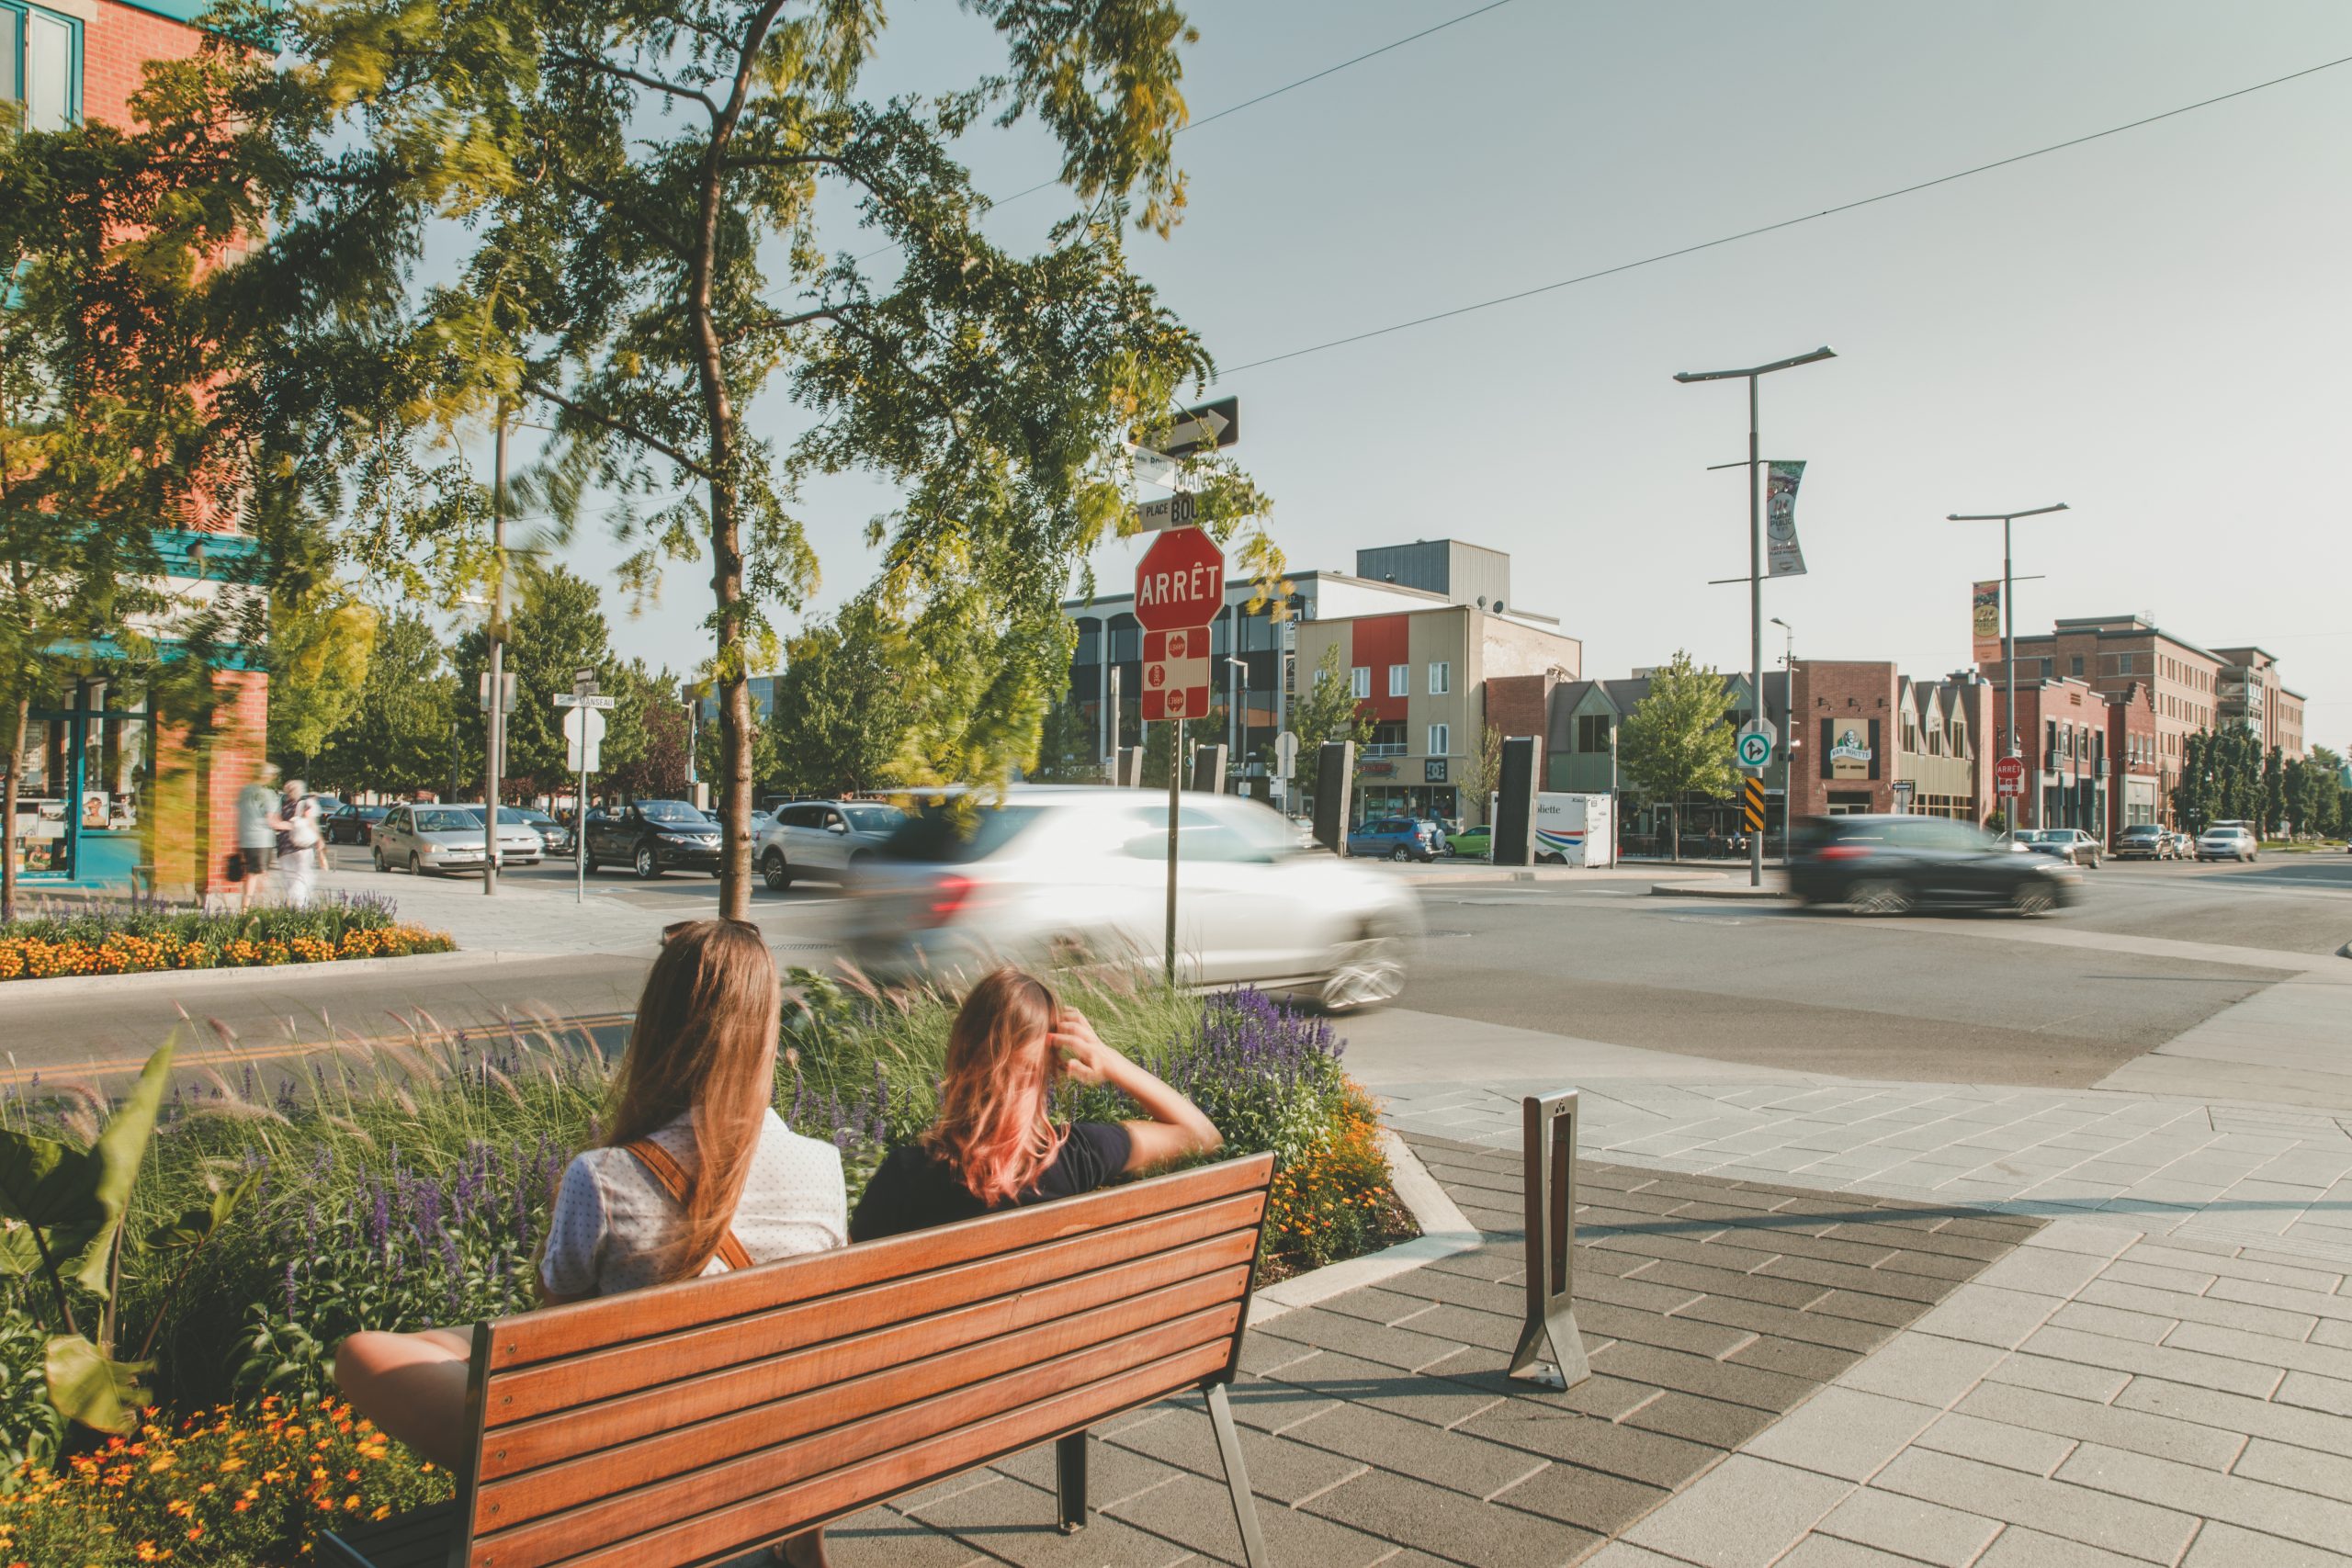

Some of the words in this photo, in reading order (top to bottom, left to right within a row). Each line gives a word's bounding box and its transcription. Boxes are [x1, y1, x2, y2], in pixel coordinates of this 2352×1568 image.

[1149, 457, 1169, 472] BOUL
[1146, 502, 1169, 518] PLACE
[1139, 561, 1219, 606] ARRÊT
[579, 697, 613, 707] MANSEAU
[1997, 764, 2020, 773] ARRÊT
[1537, 804, 1561, 814] oliette
